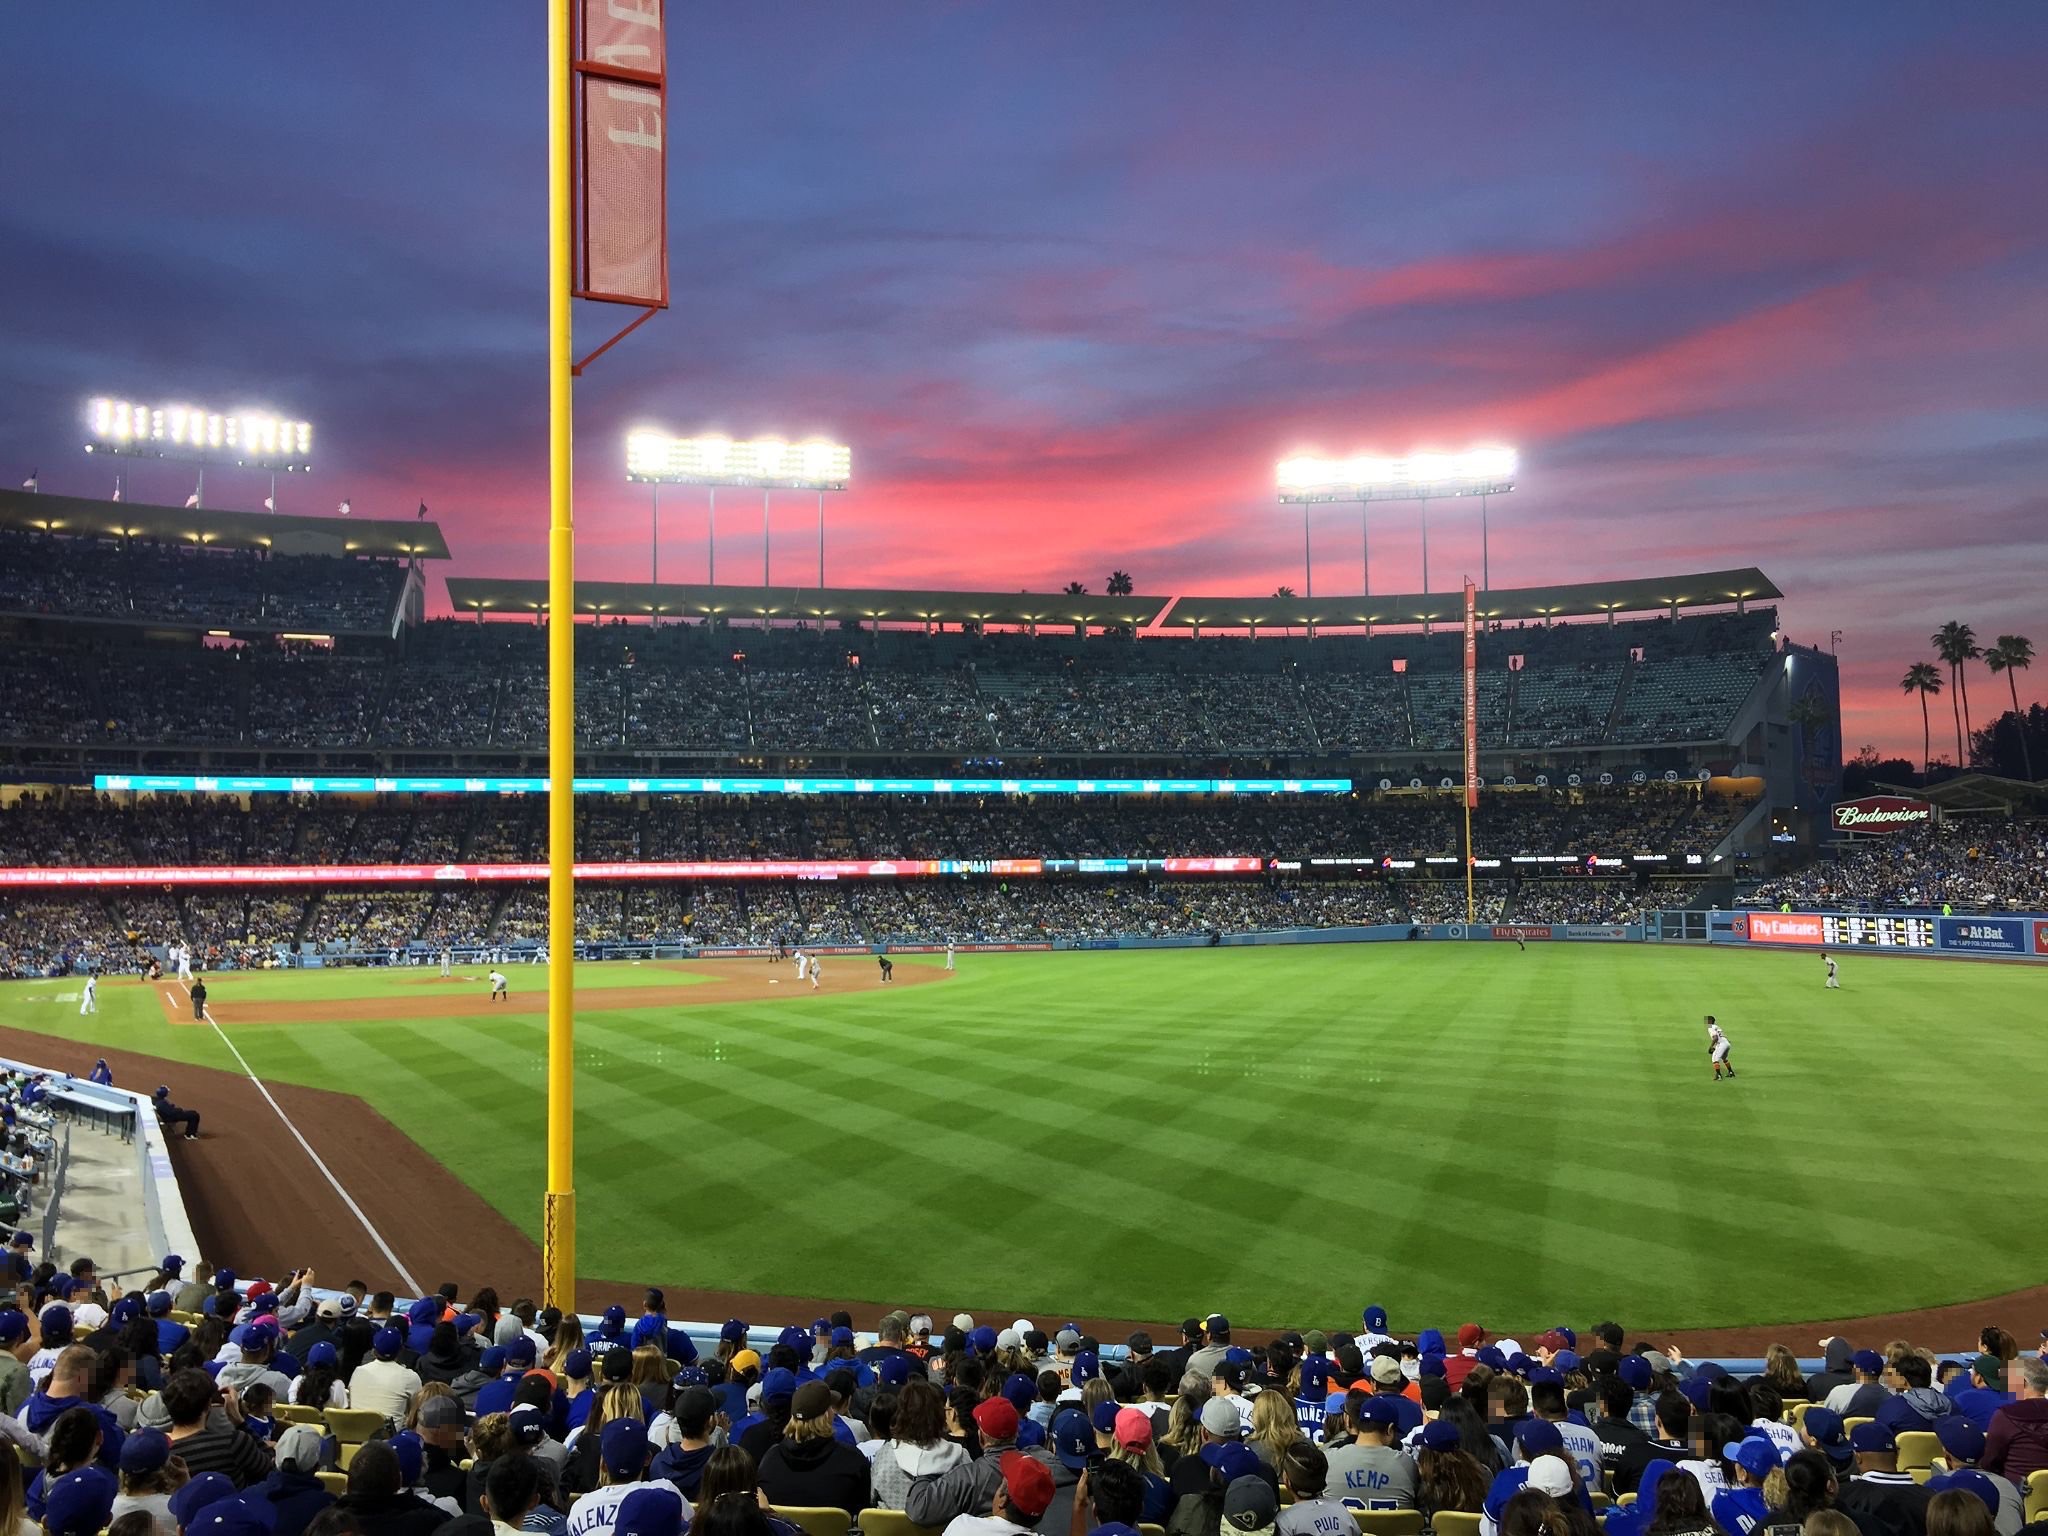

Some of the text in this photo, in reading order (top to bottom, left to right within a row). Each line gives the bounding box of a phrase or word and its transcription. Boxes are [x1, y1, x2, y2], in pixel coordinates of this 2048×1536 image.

[1835, 807, 1928, 826] Budweiser
[1496, 928, 1510, 937] Fly
[1735, 921, 1744, 931] 76
[1753, 919, 1771, 936] Fly
[1772, 920, 1818, 935] Emirates
[1969, 926, 2004, 940] At Bat
[1375, 1317, 1382, 1327] B
[1080, 1366, 1088, 1377] LA
[1075, 1438, 1085, 1452] LA
[1345, 1470, 1389, 1490] KEMP
[1314, 1517, 1340, 1534] PUIG
